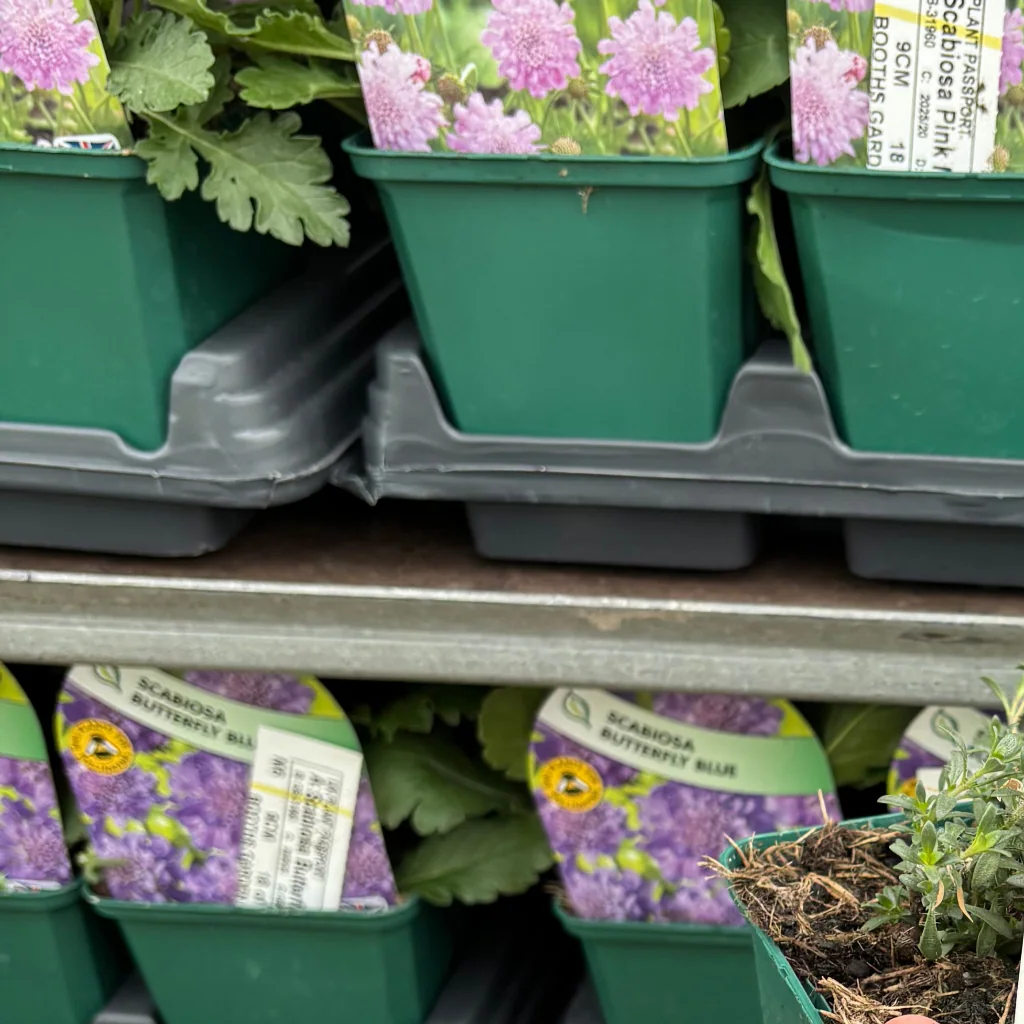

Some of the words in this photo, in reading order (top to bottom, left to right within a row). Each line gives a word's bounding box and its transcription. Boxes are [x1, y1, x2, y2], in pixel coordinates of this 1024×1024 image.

[965, 0, 981, 49] PLANT
[869, 16, 889, 104] BOOTHS
[893, 41, 911, 87] 9CM
[937, 0, 965, 100] Scabiosa
[867, 110, 885, 167] GARD
[917, 94, 931, 139] 2025/20
[933, 109, 956, 157] Pink
[889, 142, 905, 163] 18
[131, 691, 221, 739] BUTTERFLY
[138, 676, 228, 725] SCABIOSA
[601, 727, 690, 768] BUTTERFLY
[695, 757, 738, 778] BLUE
[607, 710, 695, 753] SCABIOSA
